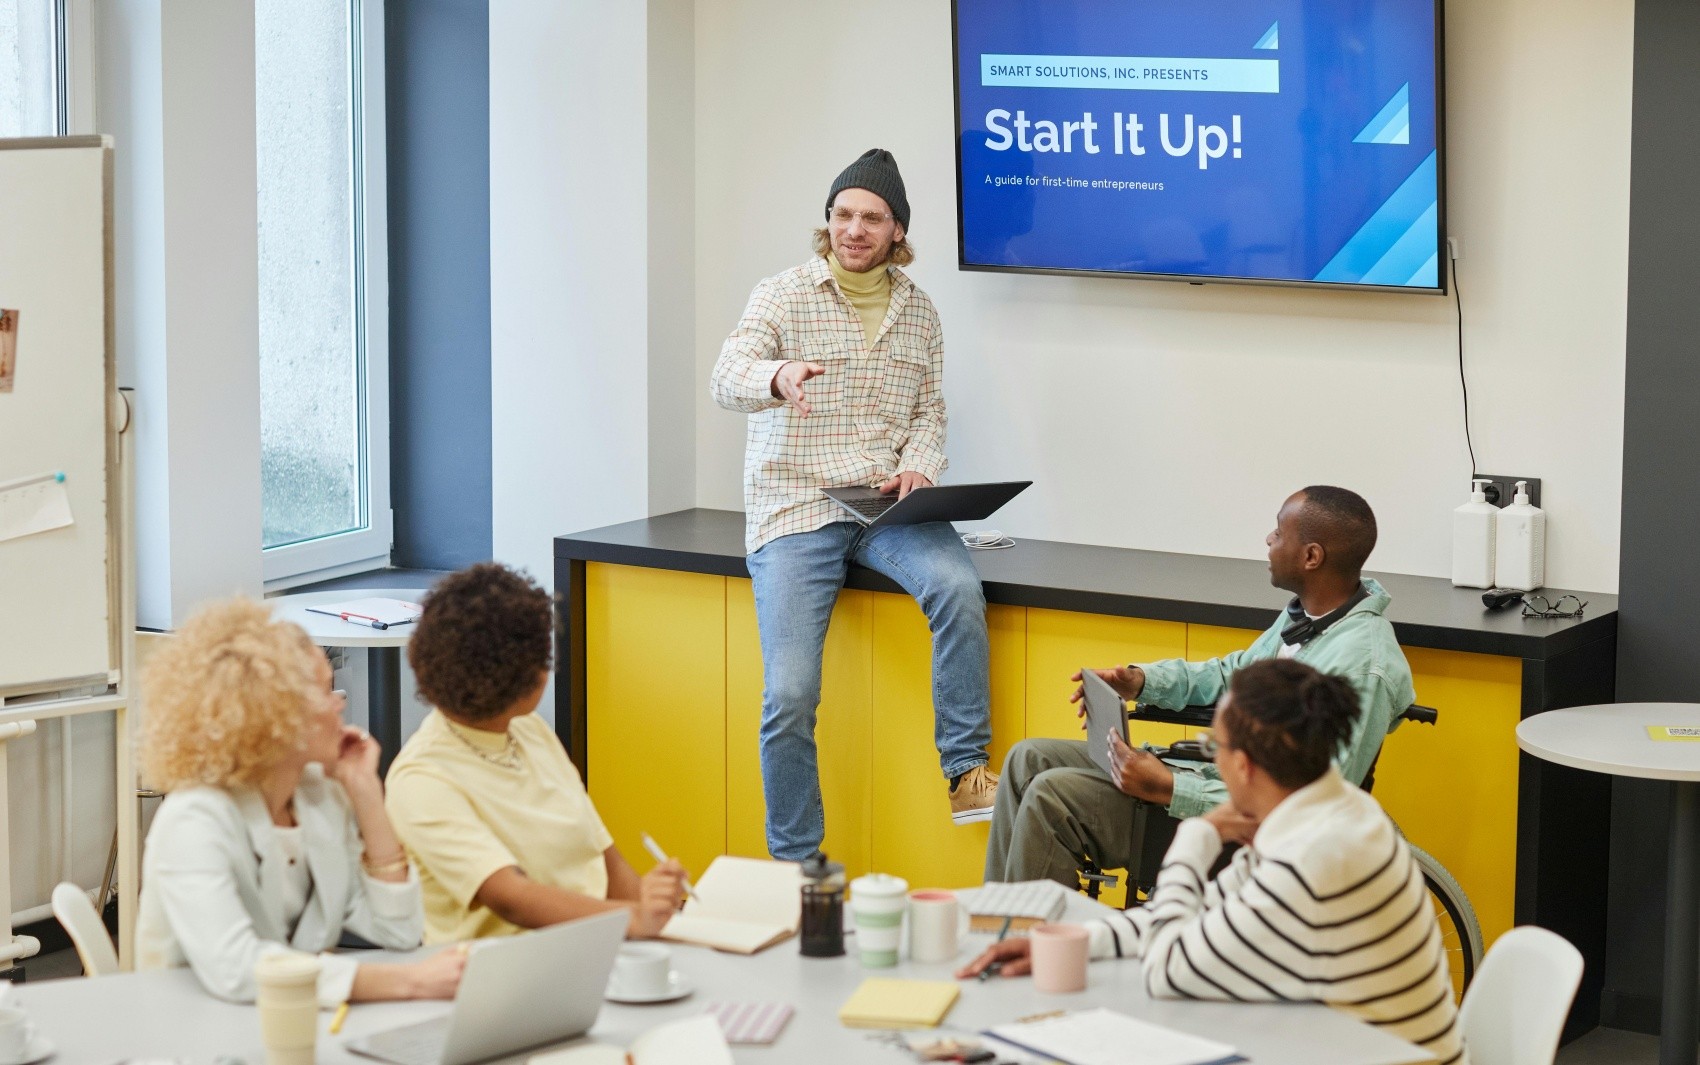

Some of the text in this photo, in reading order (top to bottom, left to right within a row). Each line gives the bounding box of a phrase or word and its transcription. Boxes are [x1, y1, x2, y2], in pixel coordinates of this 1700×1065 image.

[989, 65, 1209, 81] SMART SOLUTIONS, INC. PRESENTS
[984, 108, 1242, 170] Start It Up!
[984, 174, 1165, 192] A guide for first-time entrepreneurs
